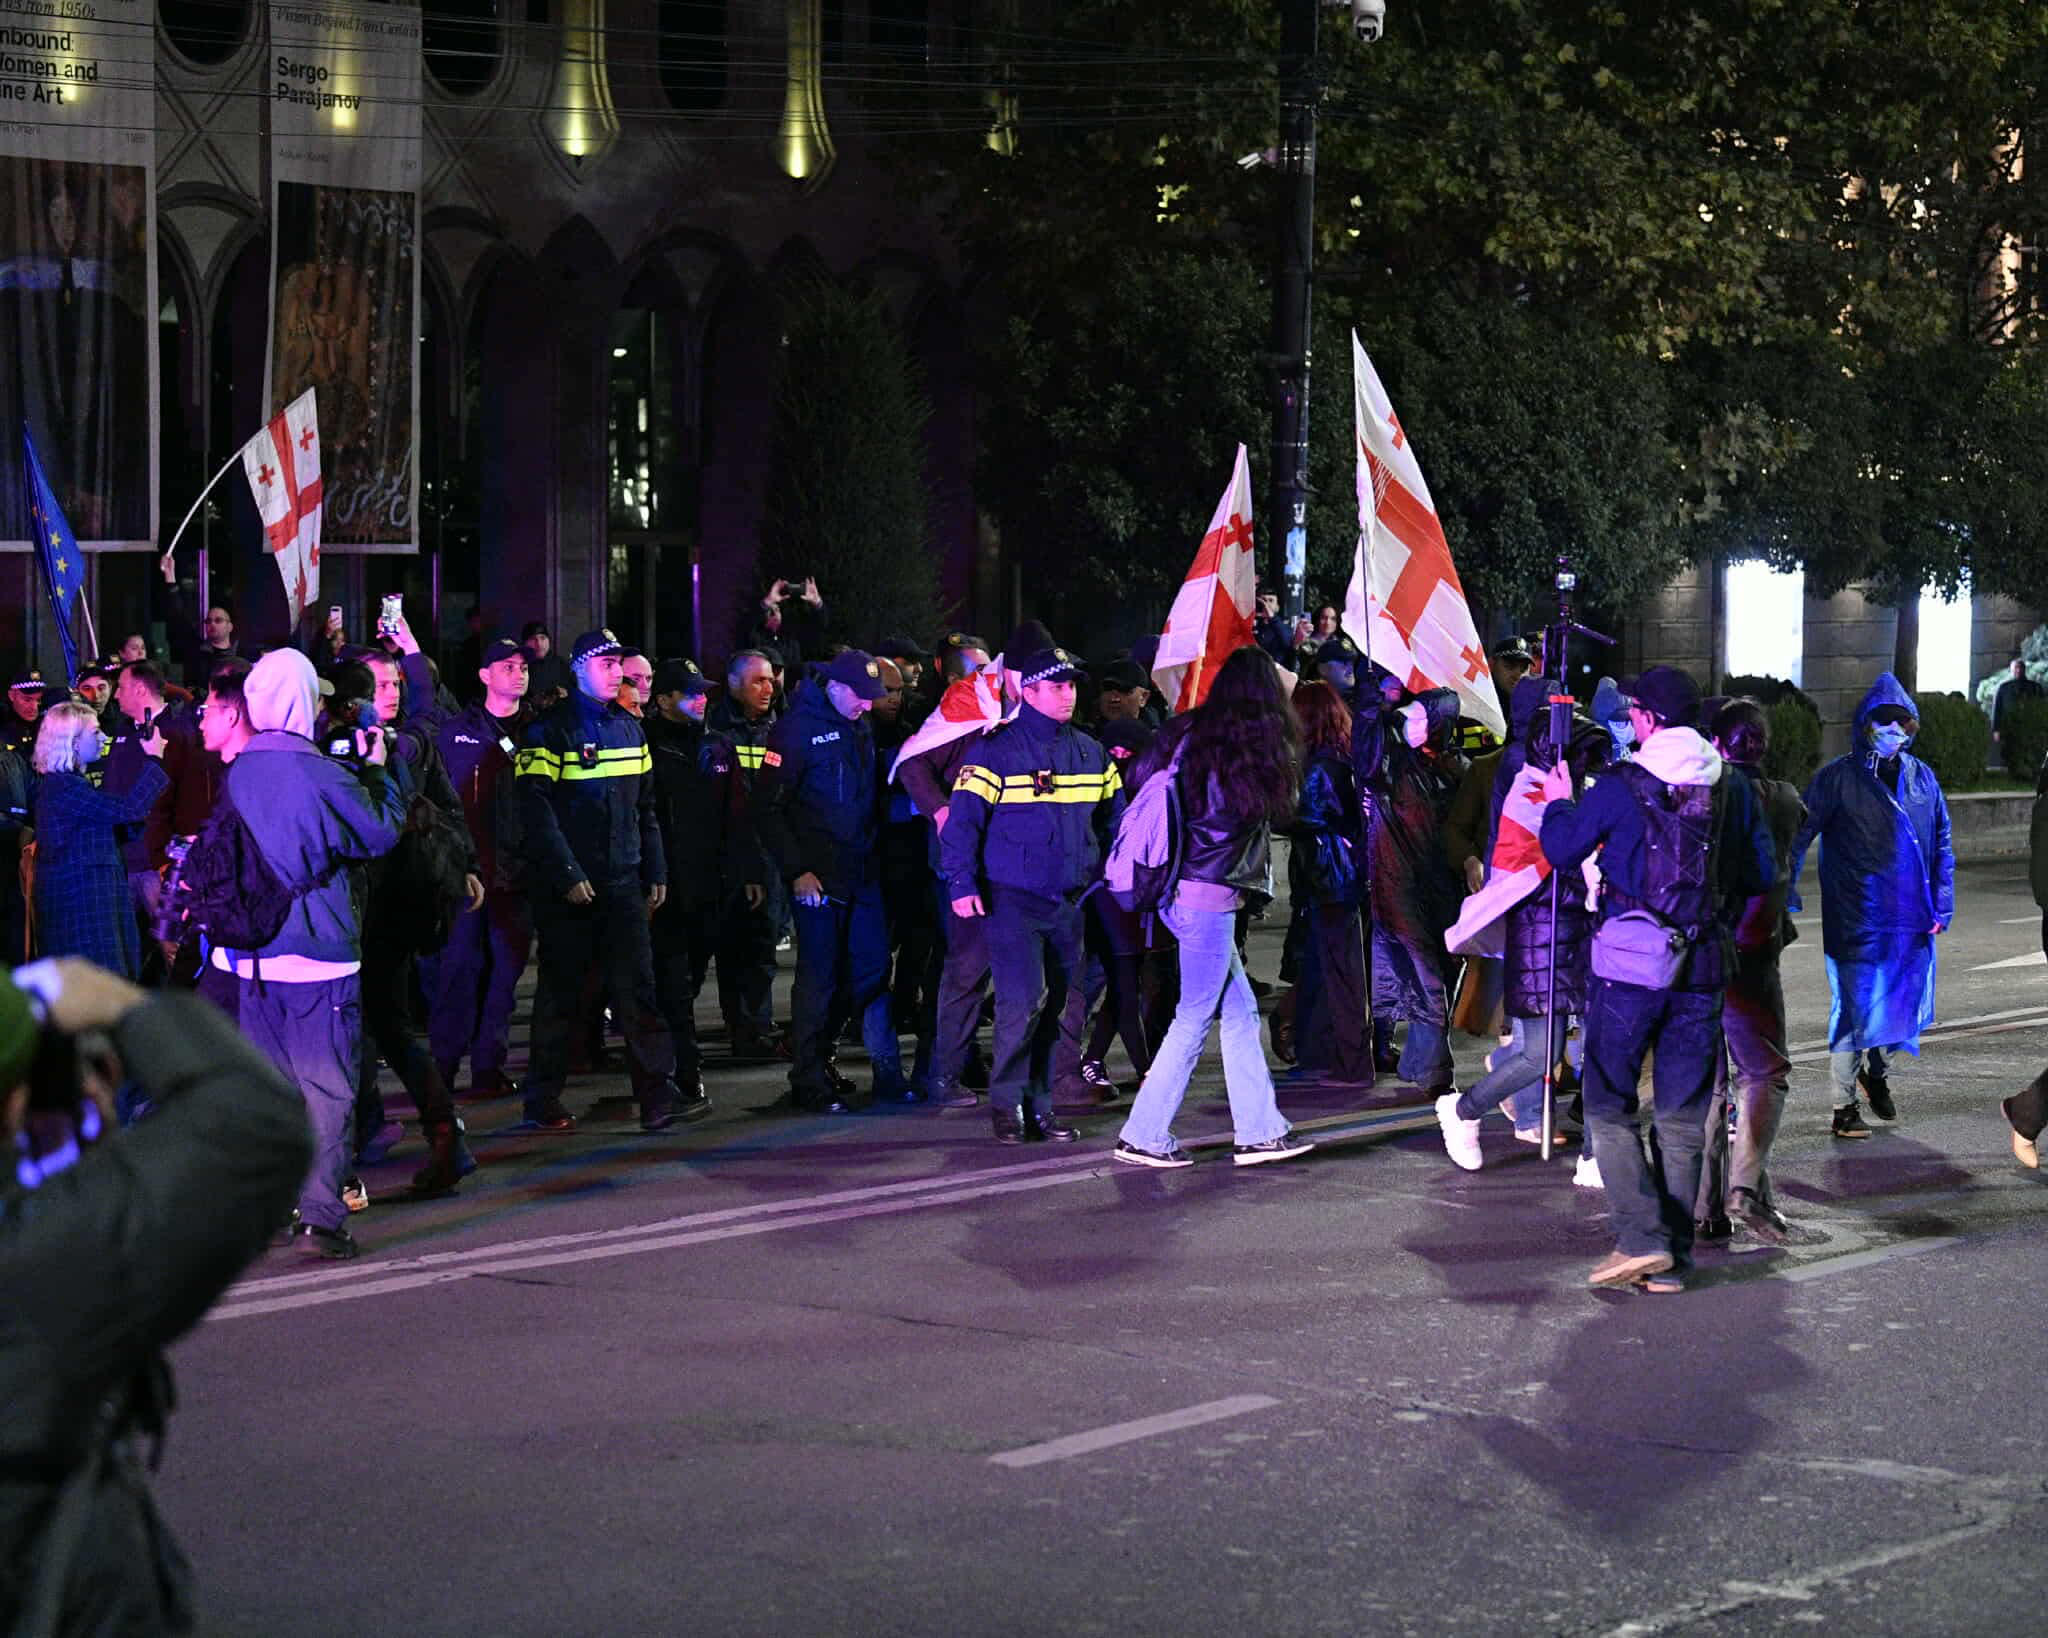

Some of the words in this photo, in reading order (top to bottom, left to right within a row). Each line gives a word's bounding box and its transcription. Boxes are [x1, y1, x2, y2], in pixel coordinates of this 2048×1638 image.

[59, 0, 97, 18] 1950s
[64, 61, 98, 81] and
[277, 56, 328, 84] Sergo
[33, 83, 63, 105] Art
[277, 82, 361, 111] Parajanov
